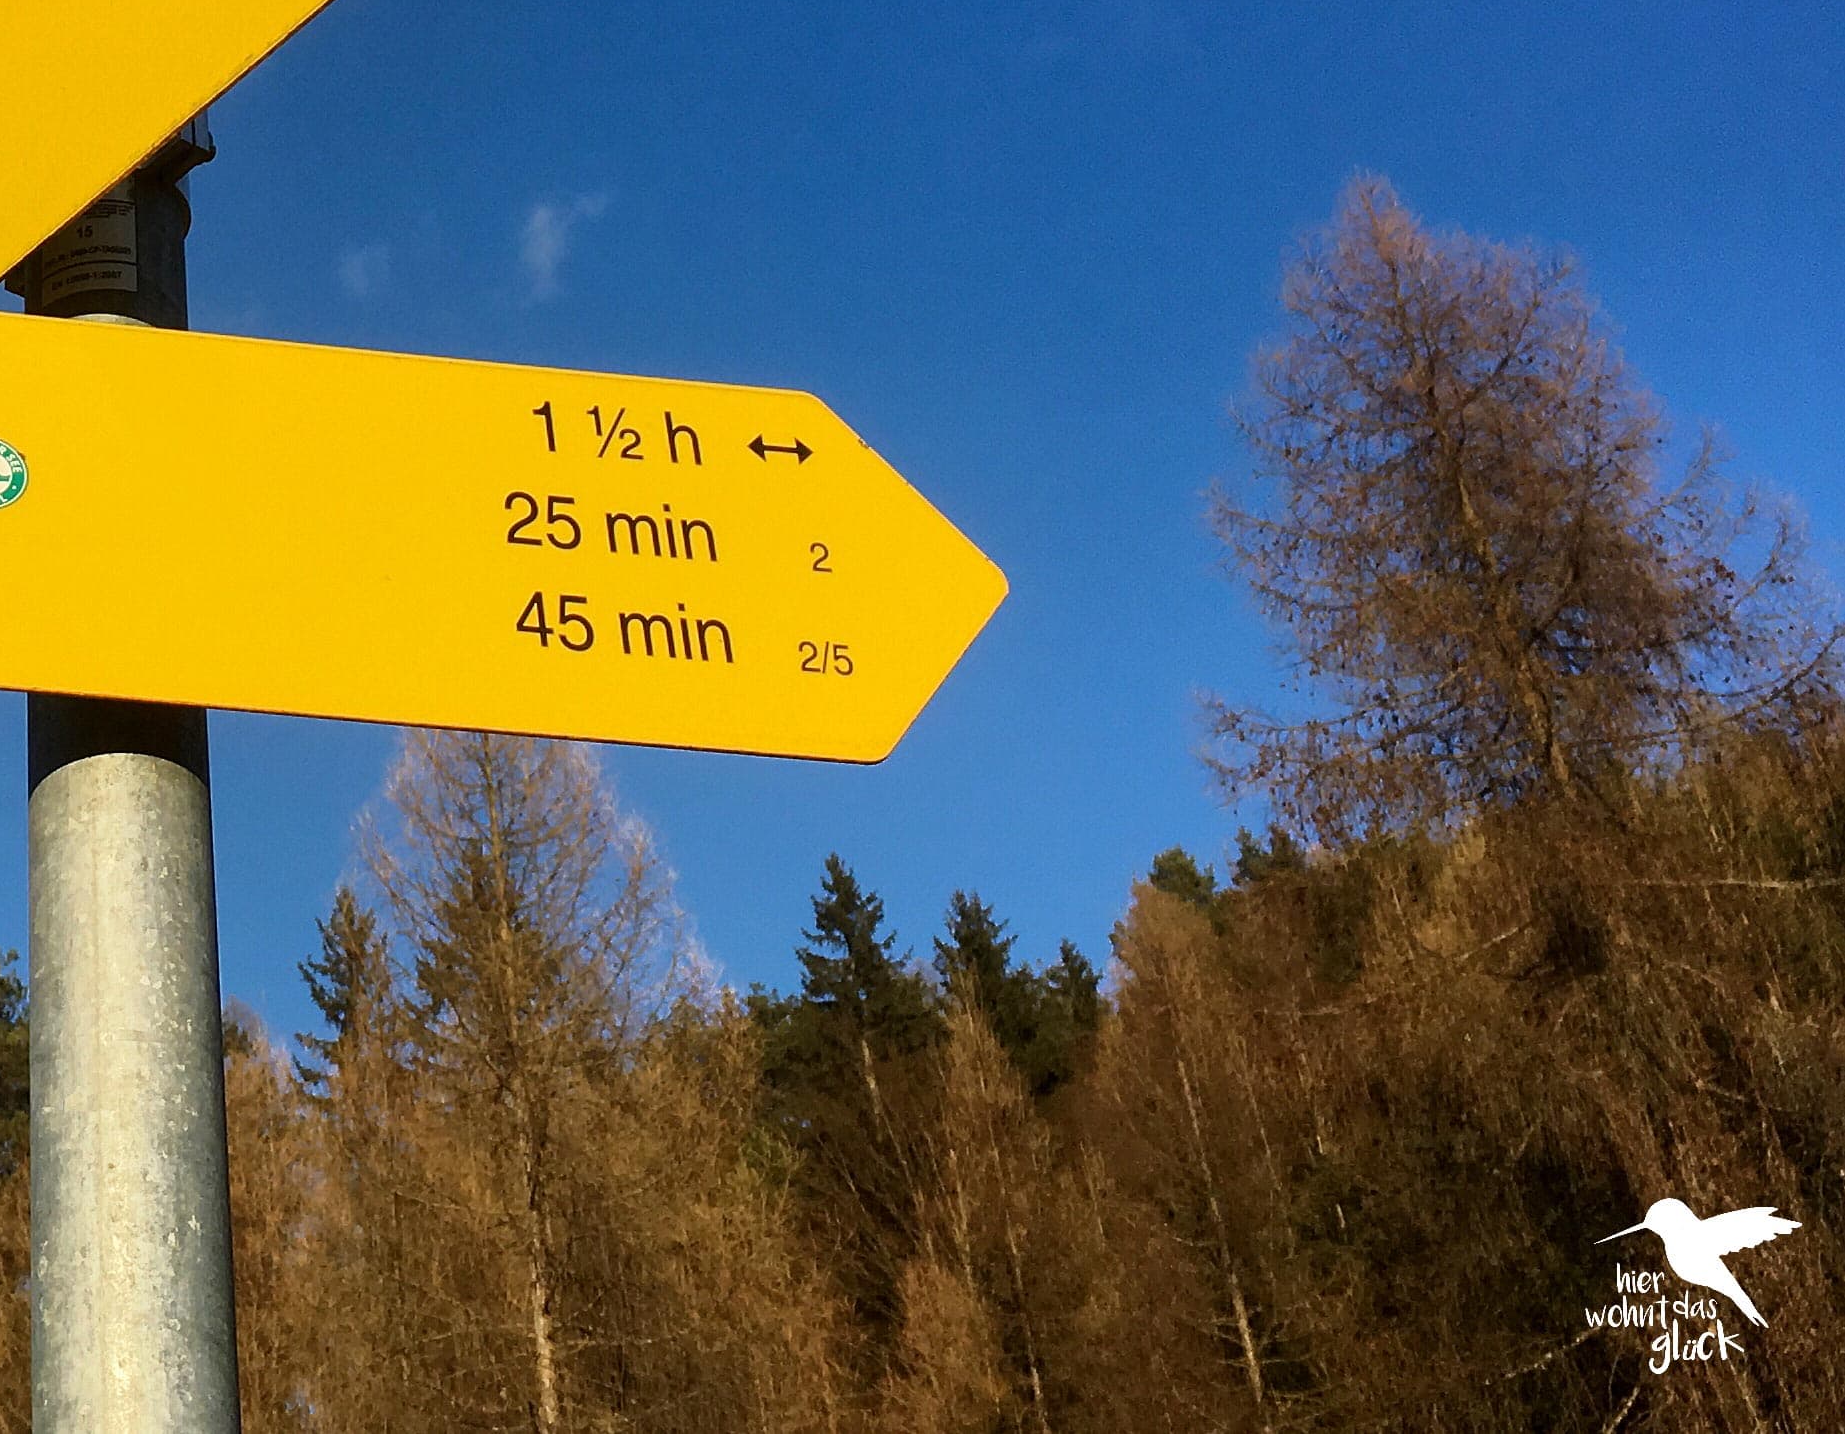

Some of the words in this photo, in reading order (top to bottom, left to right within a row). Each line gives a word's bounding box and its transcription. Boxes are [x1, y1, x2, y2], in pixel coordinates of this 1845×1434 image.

[533, 401, 556, 452] 1
[664, 411, 702, 466] h
[6, 453, 23, 473] SEE
[504, 491, 582, 550] 25
[606, 504, 717, 562] min
[810, 542, 832, 573] 2
[516, 591, 595, 652] 45
[619, 603, 733, 663] min
[798, 641, 854, 676] 2/5
